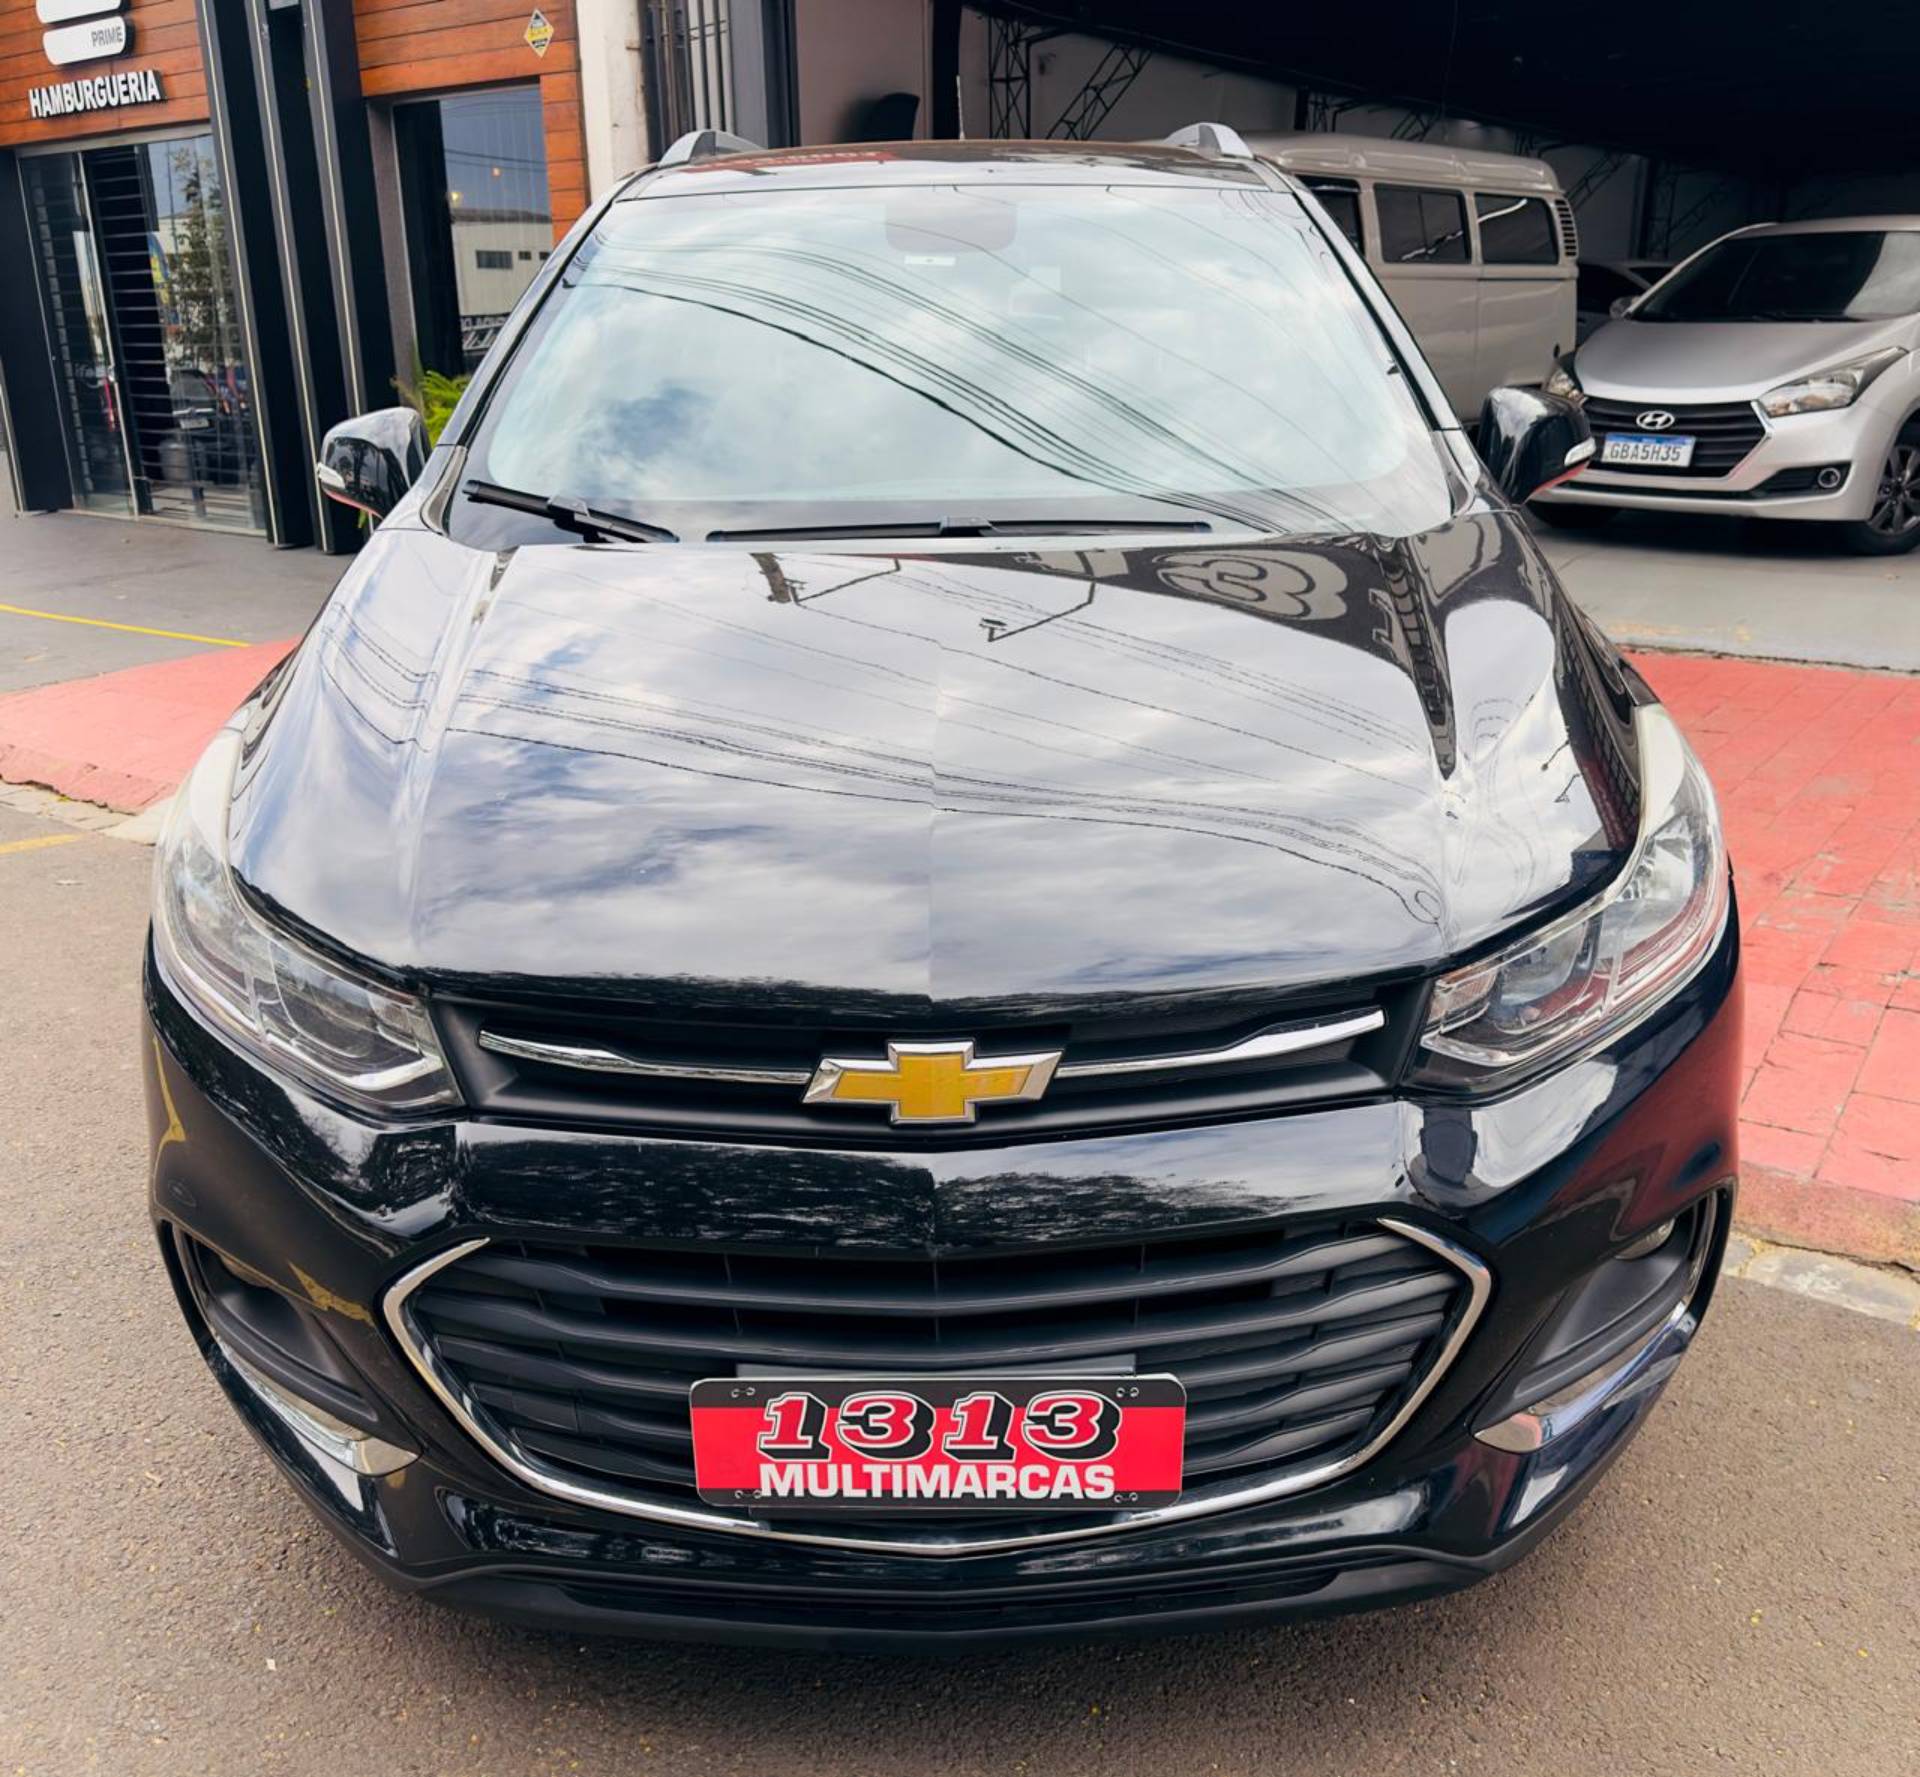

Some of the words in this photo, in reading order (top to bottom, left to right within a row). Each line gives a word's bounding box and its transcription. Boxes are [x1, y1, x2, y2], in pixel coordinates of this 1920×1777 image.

[91, 27, 123, 46] PRIME
[28, 70, 161, 118] HAMBURGUERIA
[1611, 443, 1681, 462] GBA5H35
[756, 1391, 1123, 1462] 1313
[759, 1463, 1115, 1499] MULTIMARCAS
